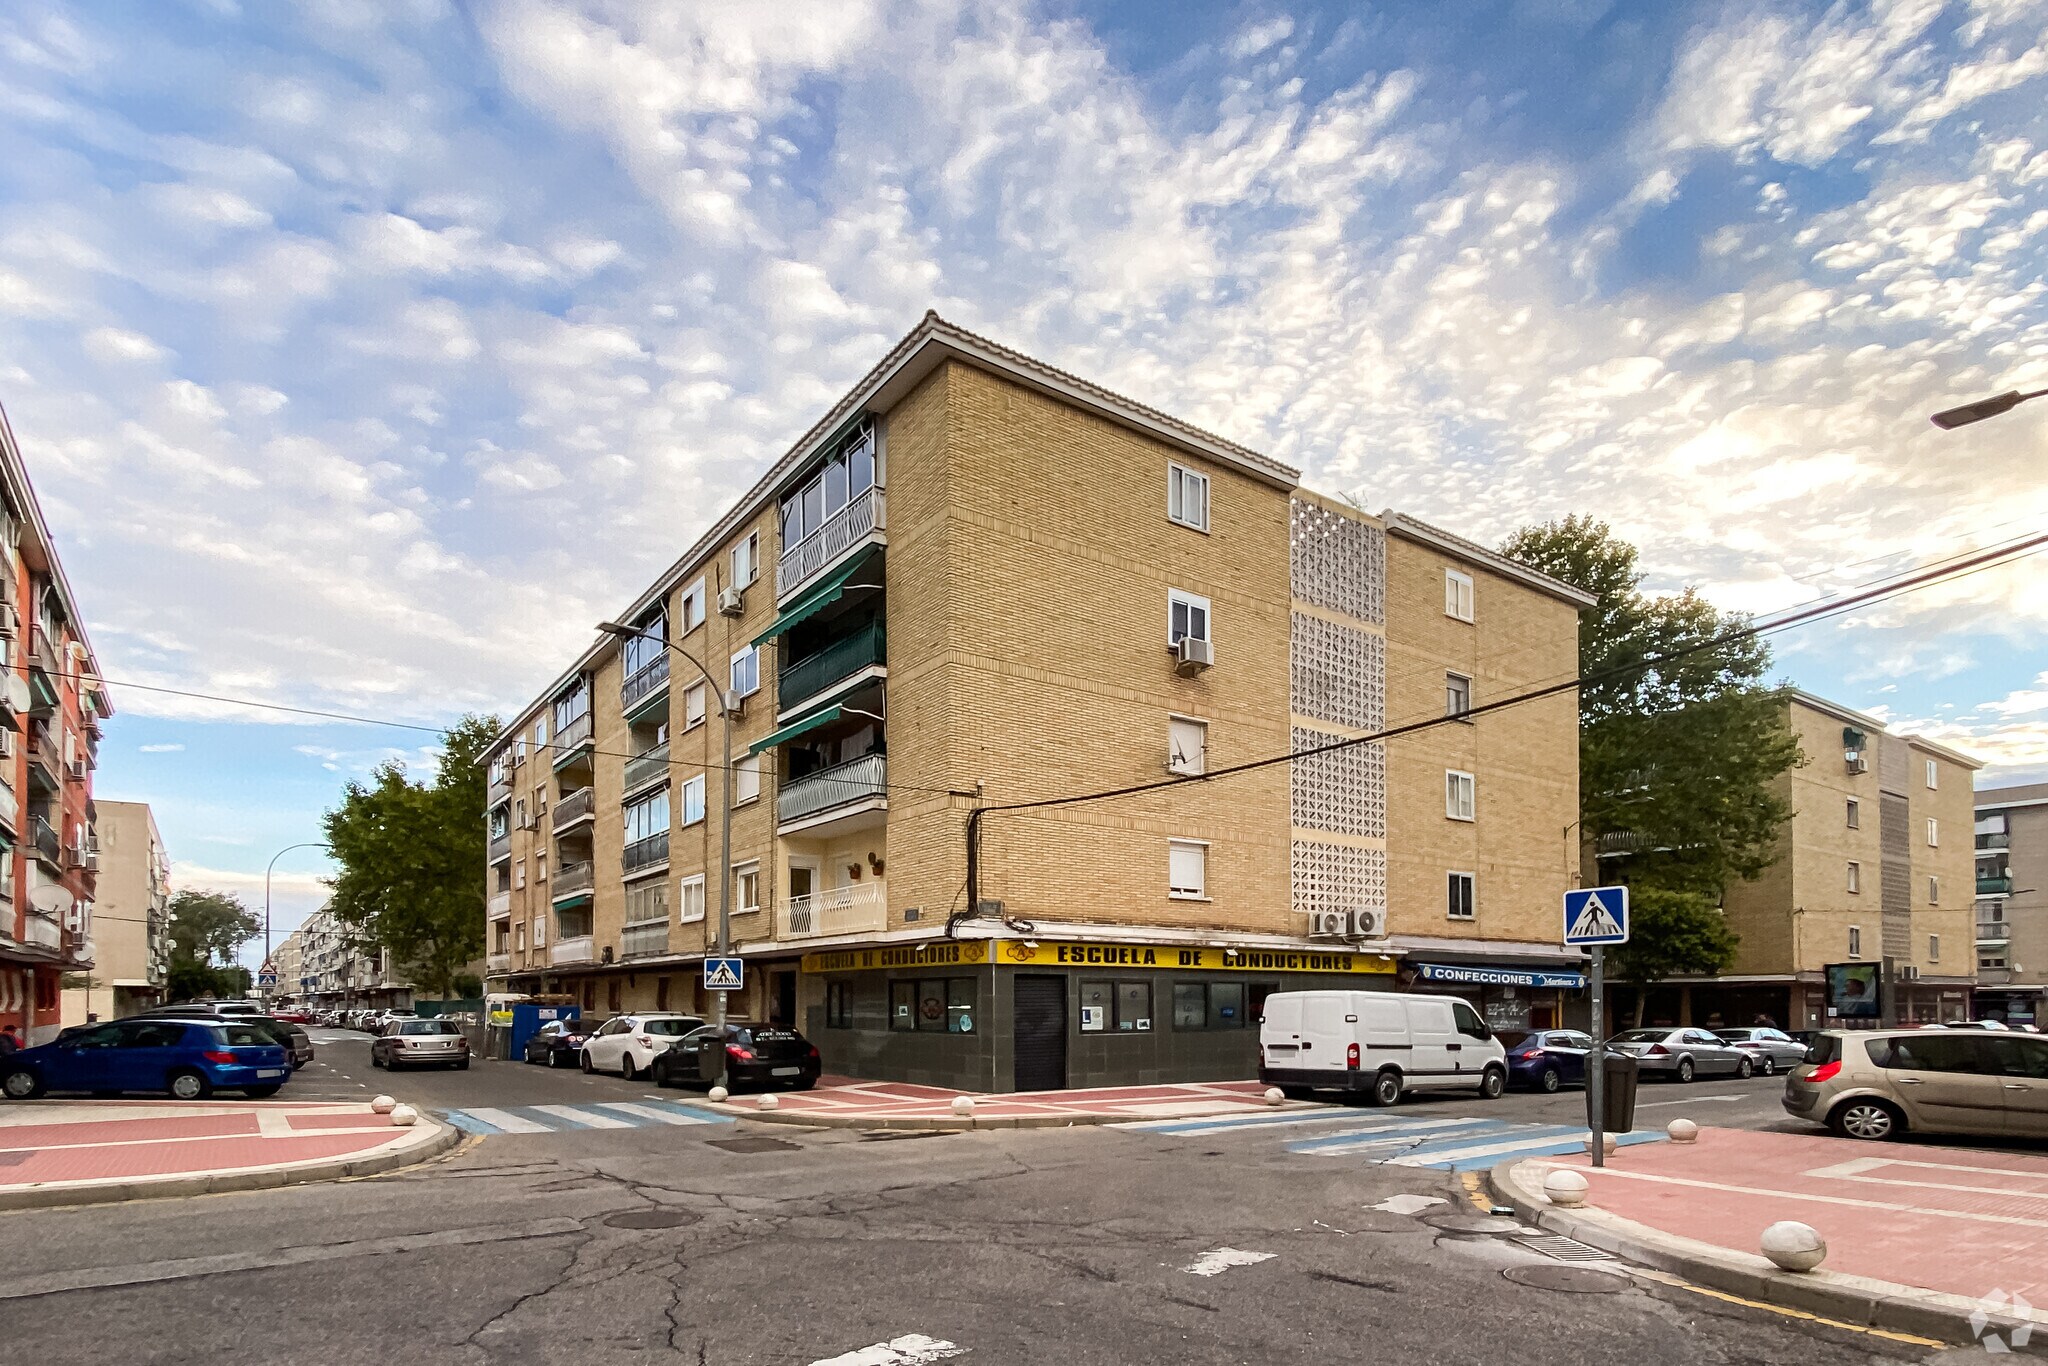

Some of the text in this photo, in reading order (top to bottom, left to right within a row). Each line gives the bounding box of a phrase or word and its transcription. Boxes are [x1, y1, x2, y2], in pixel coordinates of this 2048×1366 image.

[862, 951, 874, 966] DE
[881, 945, 960, 966] CONDUCTORES
[1057, 945, 1157, 965] ESCUELA
[1178, 950, 1202, 966] DE
[1222, 952, 1353, 970] CONDUCTORES
[1434, 968, 1534, 985] CONFECCIONES
